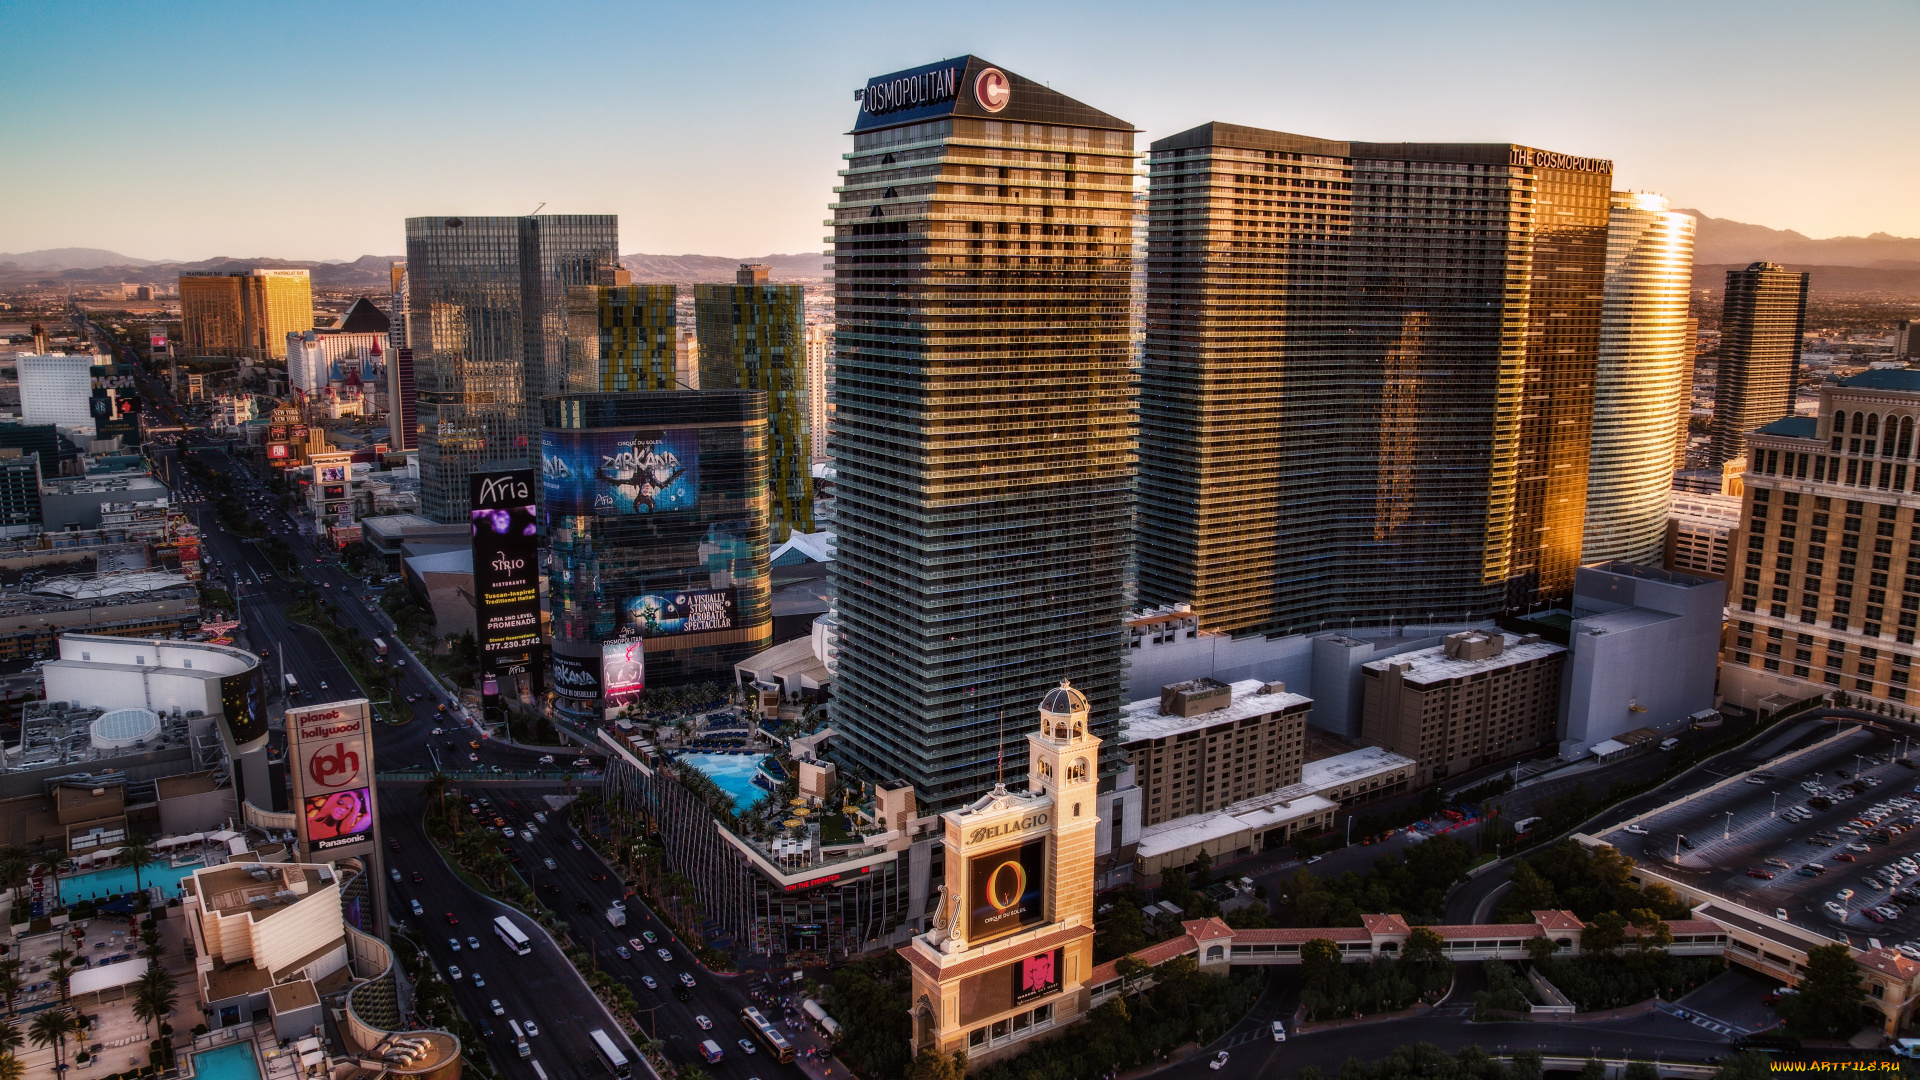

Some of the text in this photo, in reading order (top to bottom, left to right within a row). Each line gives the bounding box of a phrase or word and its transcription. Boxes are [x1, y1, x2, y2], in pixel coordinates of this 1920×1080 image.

[854, 67, 955, 113] THE COSMOPOLITAN
[1510, 148, 1614, 174] THE COSMOPOLITAN
[91, 375, 136, 389] MGM
[479, 475, 529, 505] Aria
[594, 493, 614, 507] Aria
[492, 579, 526, 587] RISTORANTE
[484, 588, 535, 599] Tuscan-Inspired
[687, 592, 726, 606] A VISUALLY
[485, 597, 517, 605] Traditional
[689, 601, 724, 614] STUNNING
[489, 615, 504, 623] ARIA
[688, 609, 727, 622] ACROBATIC
[487, 618, 536, 629] PROMENADE
[683, 618, 731, 632] SPECTACULAR
[485, 637, 541, 651] 877.230.2742
[603, 636, 643, 647] COSMOPOLITAN
[573, 690, 598, 698] DISBELIEF
[300, 710, 340, 727] planet
[301, 720, 361, 739] hollywood
[311, 742, 359, 787] ph
[965, 813, 1048, 845] BELLAGIO
[319, 833, 366, 849] Panasonic
[798, 881, 810, 889] THE
[986, 860, 1027, 909] O
[984, 914, 1003, 924] CIRQUE
[1010, 907, 1027, 915] SOLEIL
